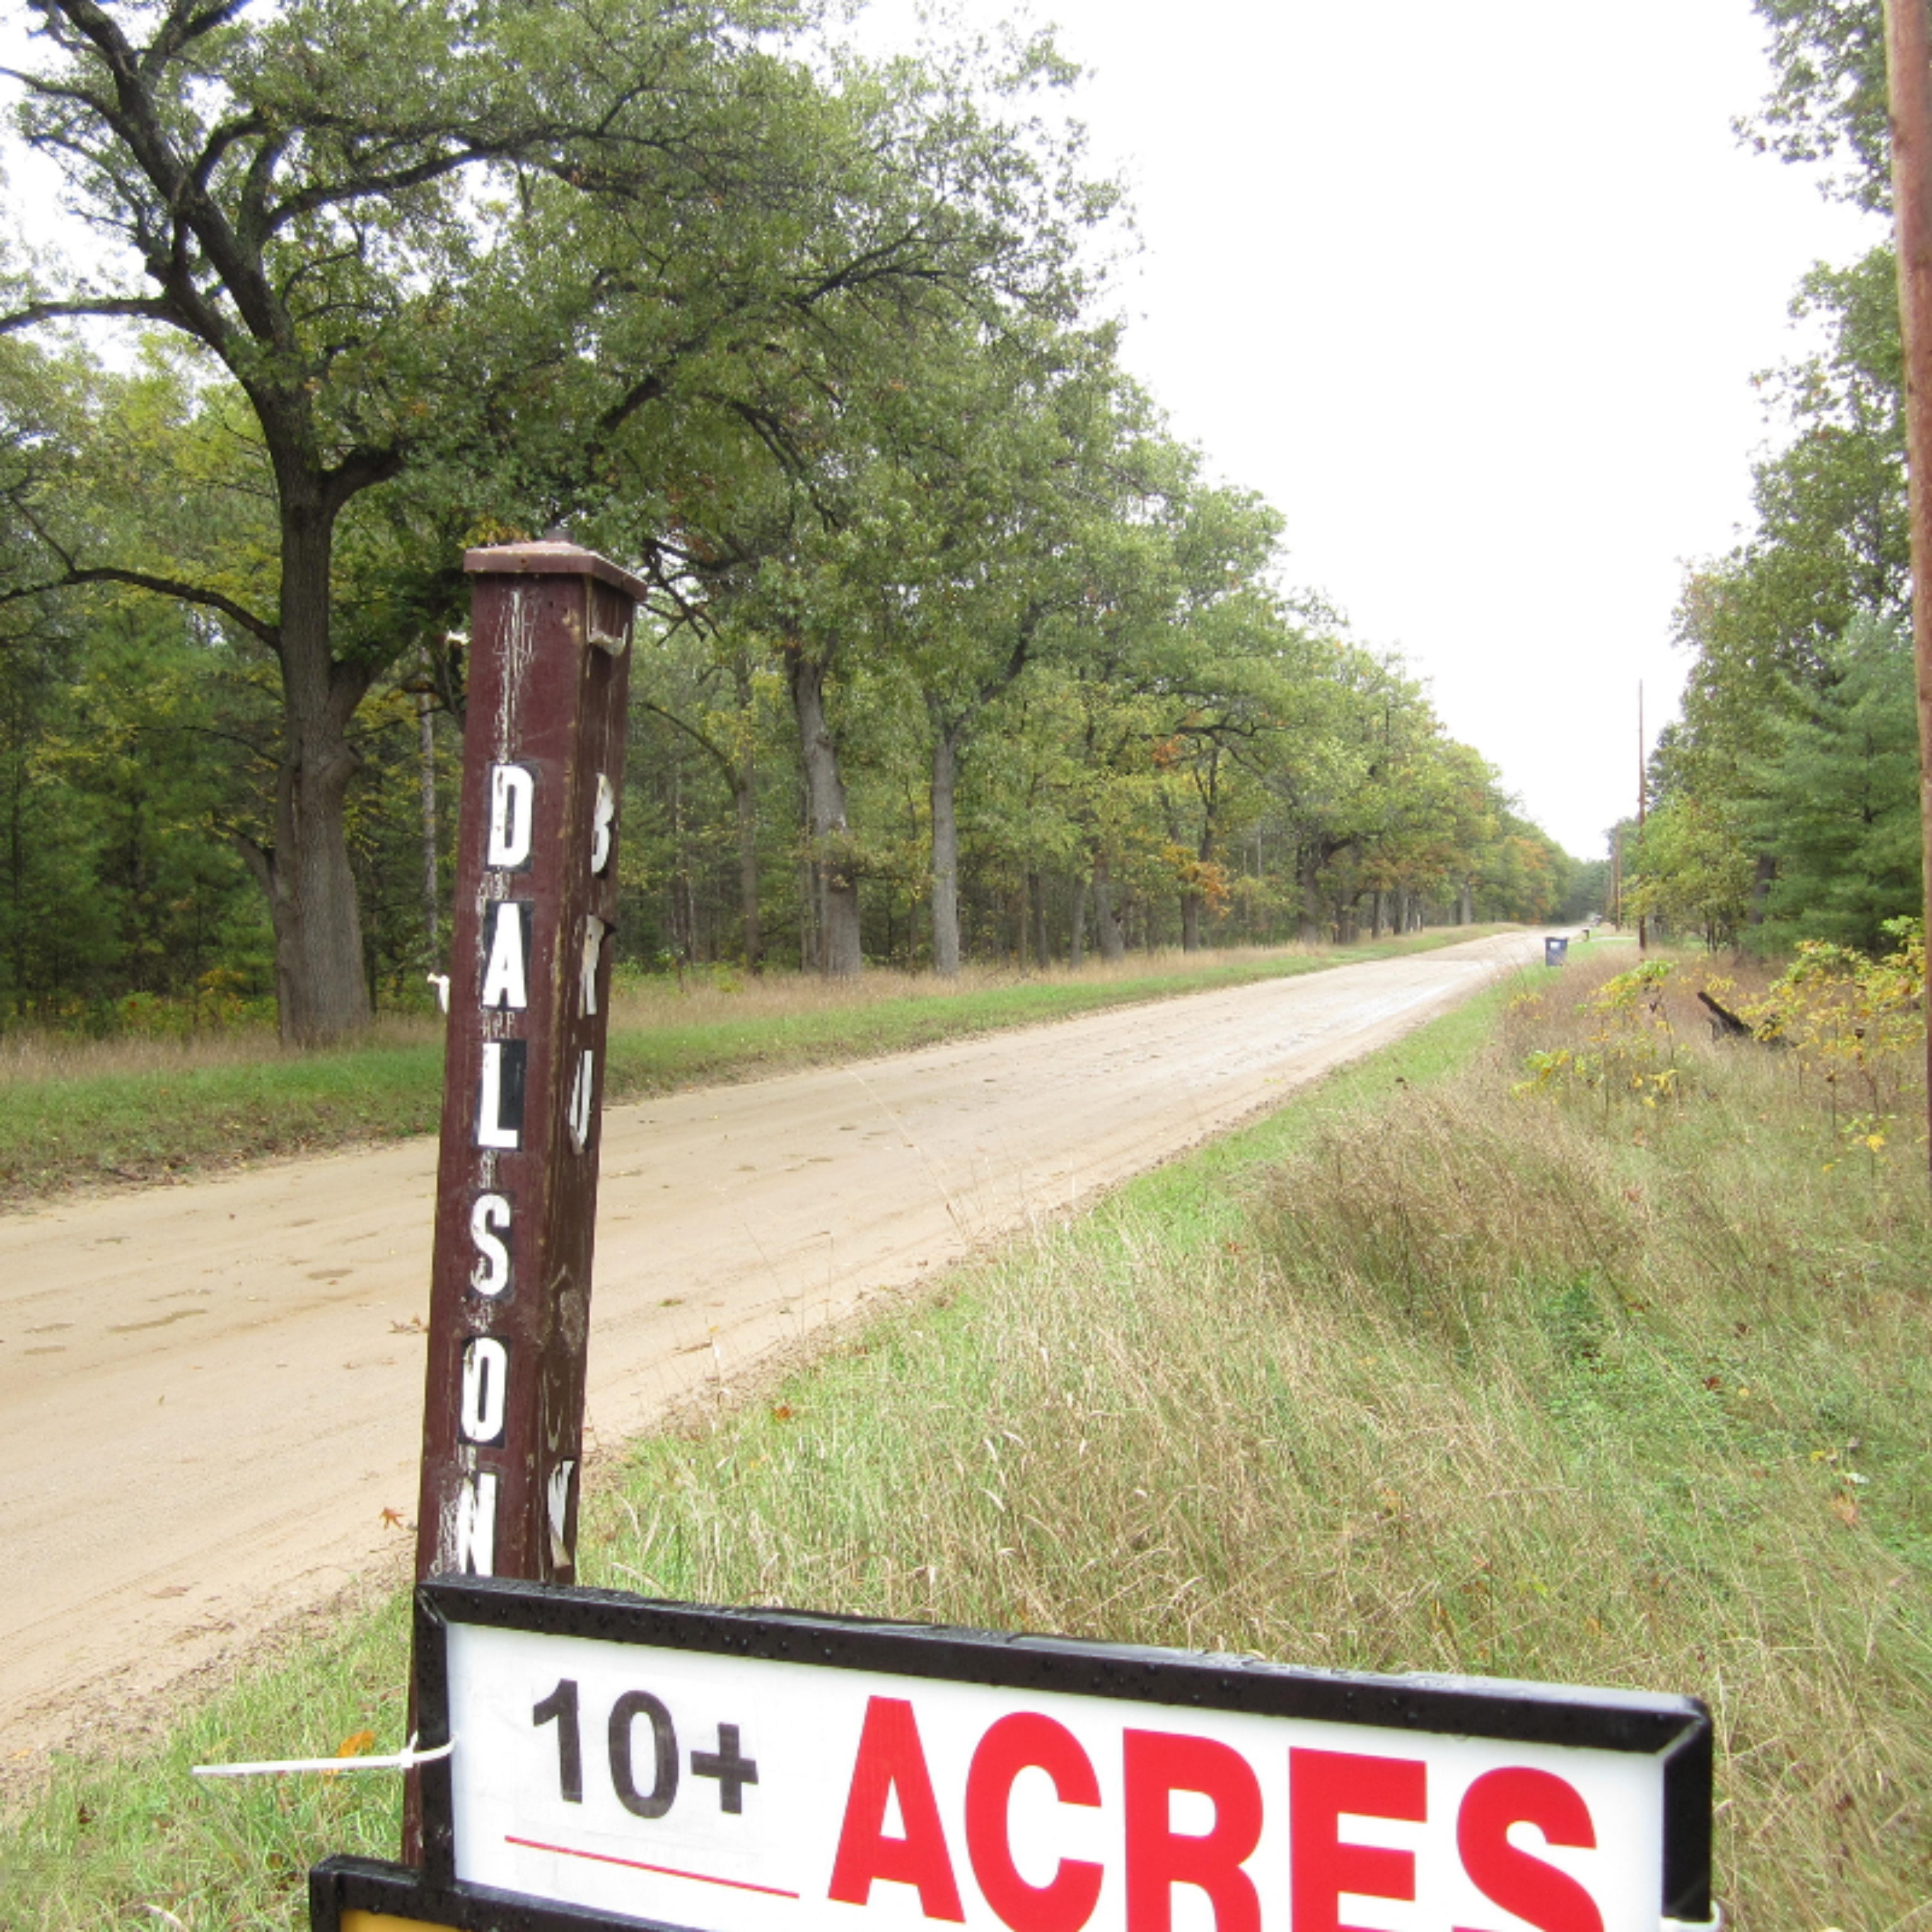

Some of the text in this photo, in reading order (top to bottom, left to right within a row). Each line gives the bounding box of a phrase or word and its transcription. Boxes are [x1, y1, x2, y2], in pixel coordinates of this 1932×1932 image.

[456, 764, 534, 1576] DALSON
[533, 1678, 1604, 1932] 10+ ACRES
